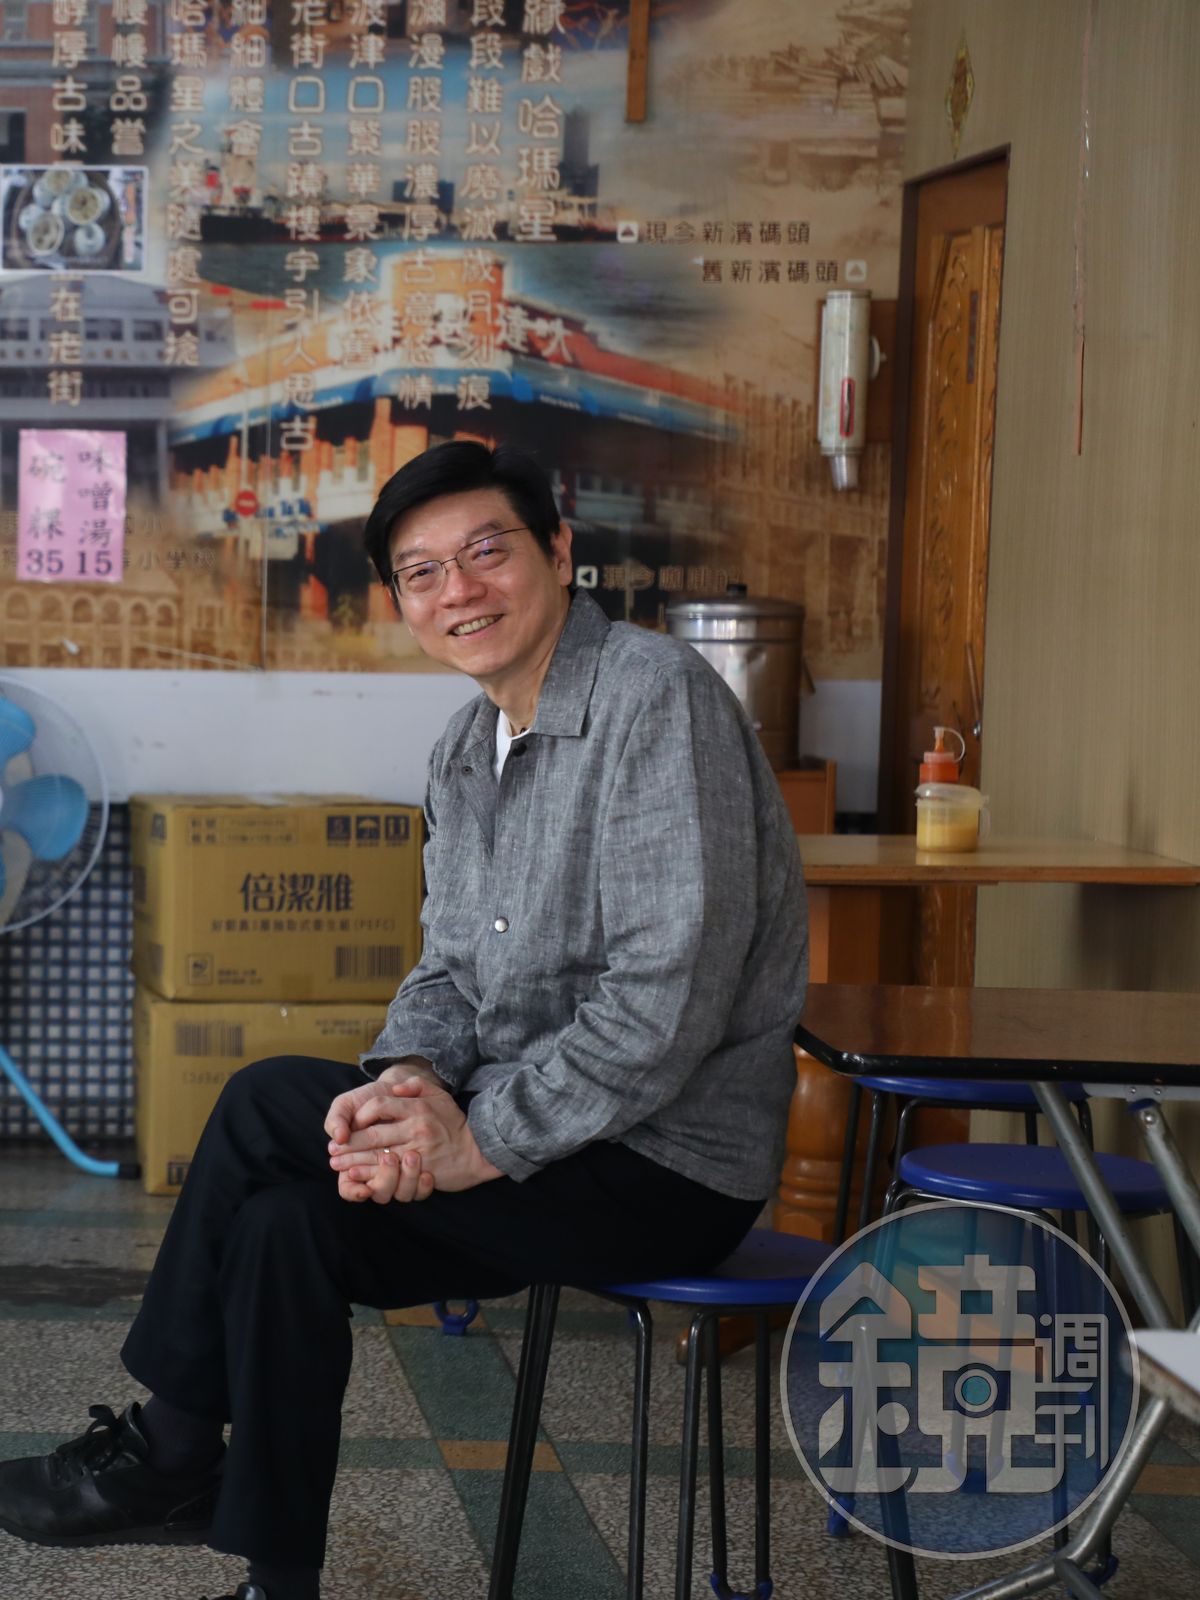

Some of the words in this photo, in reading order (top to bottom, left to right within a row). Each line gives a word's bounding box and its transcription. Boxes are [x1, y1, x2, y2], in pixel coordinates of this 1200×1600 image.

[48, 0, 88, 408] 醇厚古味在老街
[702, 259, 839, 284] 舊新濱碼頭
[77, 446, 113, 549] 味噌湯
[26, 549, 64, 576] 35
[77, 550, 112, 577] 15
[240, 872, 354, 912] 倍潔雅
